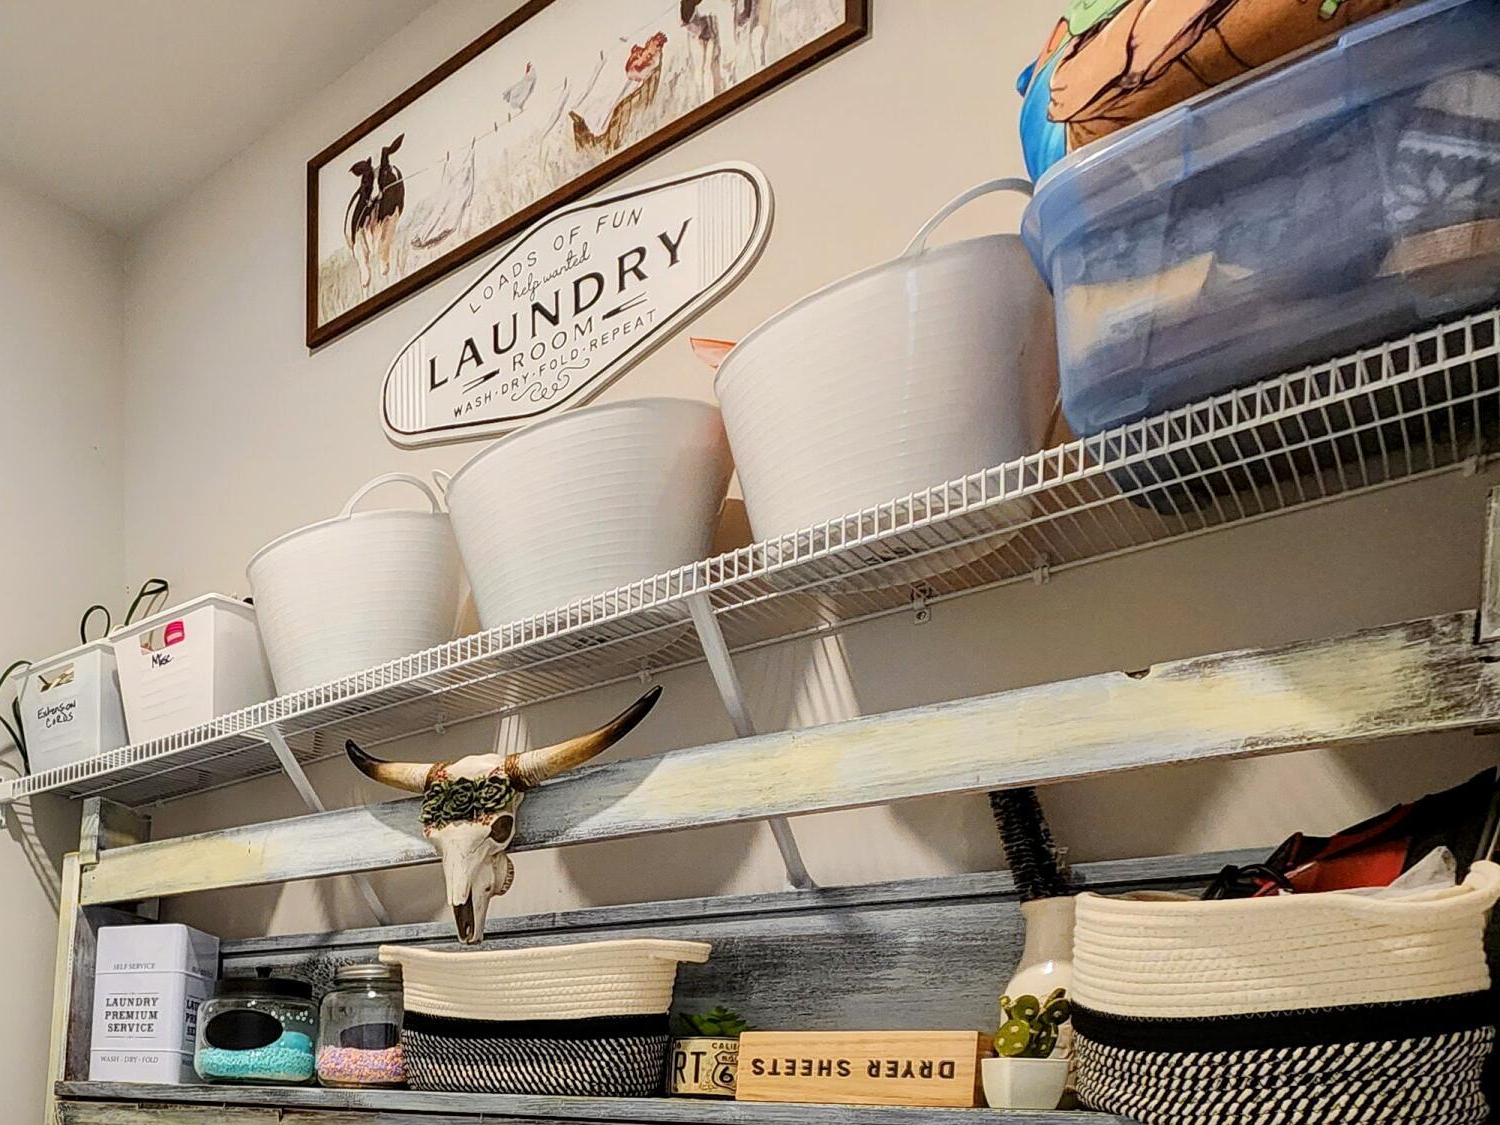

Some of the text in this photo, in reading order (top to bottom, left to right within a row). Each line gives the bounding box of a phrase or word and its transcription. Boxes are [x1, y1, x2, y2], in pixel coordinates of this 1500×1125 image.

[469, 207, 643, 314] LOADS OF FUN
[512, 241, 591, 301] help wanted
[428, 217, 693, 392] LAUNDRY
[512, 316, 594, 371] ROOM
[453, 308, 657, 418] WASH DRY FOLD REPEAT
[129, 962, 156, 970] SERVICE
[104, 1010, 159, 1020] PREMIUM
[105, 997, 159, 1007] LAUNDRY
[107, 1023, 154, 1033] SERVICE
[674, 1051, 707, 1084] RT
[718, 1066, 736, 1084] 6
[751, 1057, 956, 1080] DRYER SHEETS
